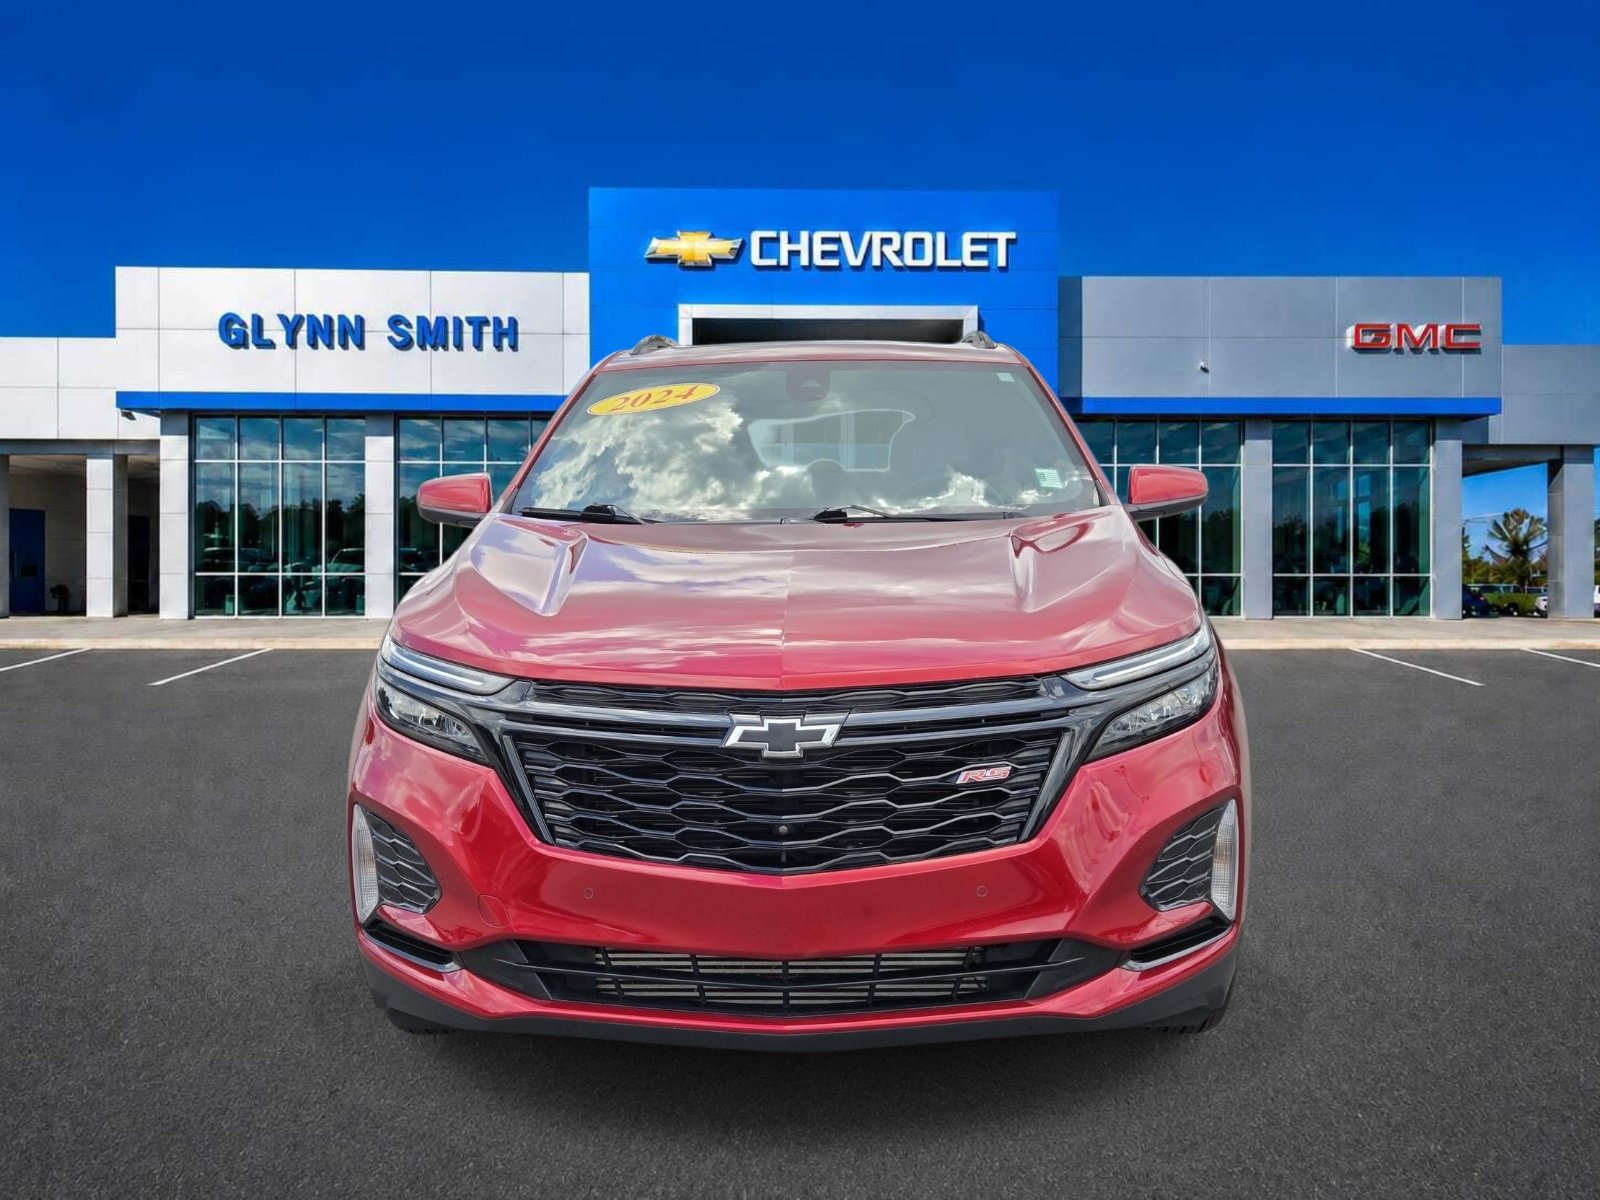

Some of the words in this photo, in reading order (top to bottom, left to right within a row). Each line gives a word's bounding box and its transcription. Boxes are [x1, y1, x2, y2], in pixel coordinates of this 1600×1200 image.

[750, 230, 1016, 268] CHEVROLET
[218, 312, 365, 349] GLYNN
[387, 314, 518, 351] SMITH
[1350, 322, 1482, 352] GMC
[609, 384, 699, 412] 2024
[955, 766, 1012, 784] RS
